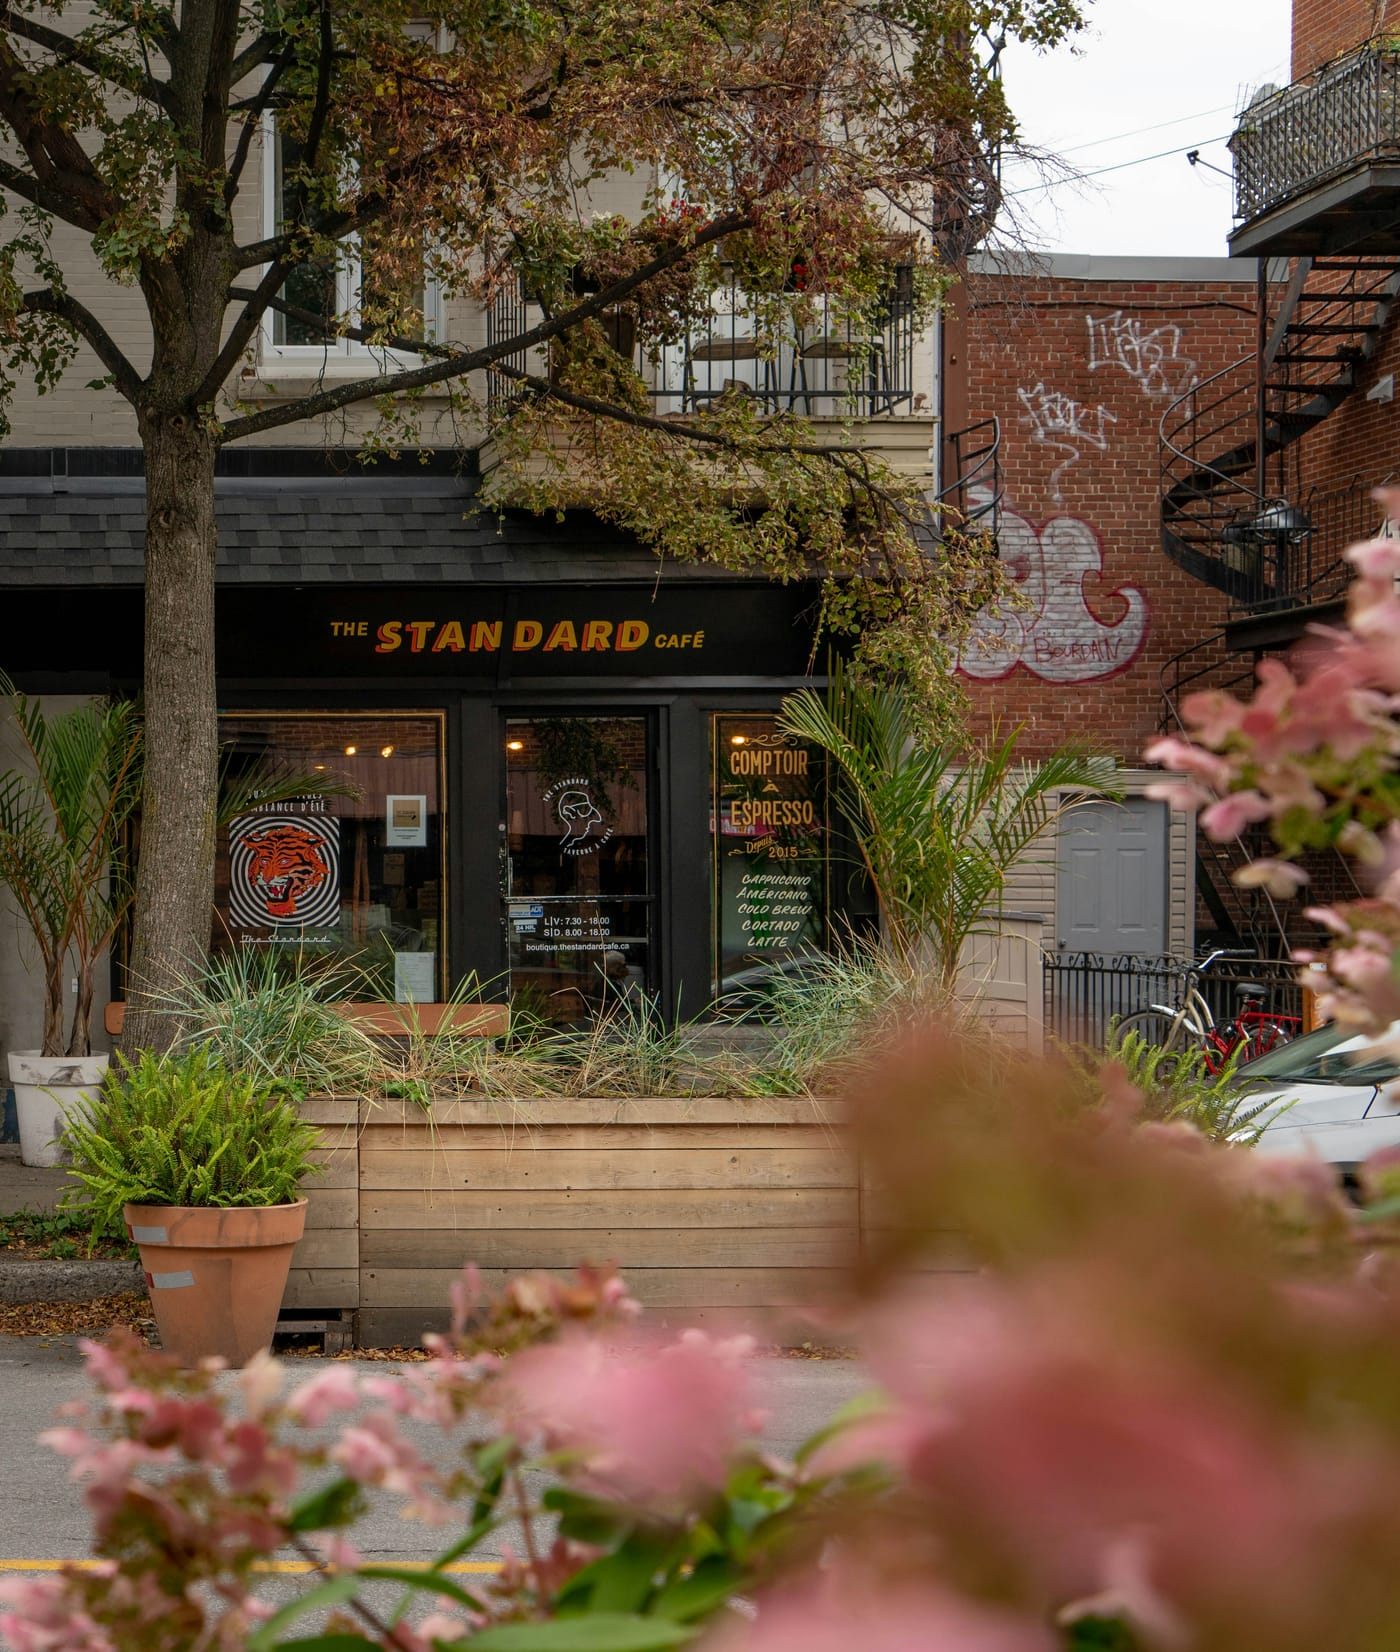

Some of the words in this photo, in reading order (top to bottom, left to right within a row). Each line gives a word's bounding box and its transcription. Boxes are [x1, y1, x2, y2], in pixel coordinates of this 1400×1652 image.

[330, 621, 369, 637] THE
[654, 630, 705, 648] CAFÉ
[731, 750, 808, 775] COMPTOIR
[245, 802, 294, 812] BIANCE
[301, 800, 325, 812] D'ÉTÉ
[731, 800, 813, 826] ESPRESSO
[745, 836, 774, 855] Depuis
[768, 846, 799, 858] 2015
[741, 874, 812, 886] CAPPUCCINO
[735, 886, 809, 901] AMÉRICANO
[737, 903, 770, 914] COLD
[771, 904, 813, 915] BREW
[565, 917, 582, 926] 7.30
[589, 917, 610, 926] 18.00
[741, 919, 801, 931] CORTADO
[241, 932, 262, 944] The
[267, 934, 331, 943] Standard
[565, 928, 582, 937] 8.00
[589, 928, 610, 937] 18.00
[526, 942, 630, 951] boutique.thestandardcafe.ca
[747, 936, 789, 947] LATTE
